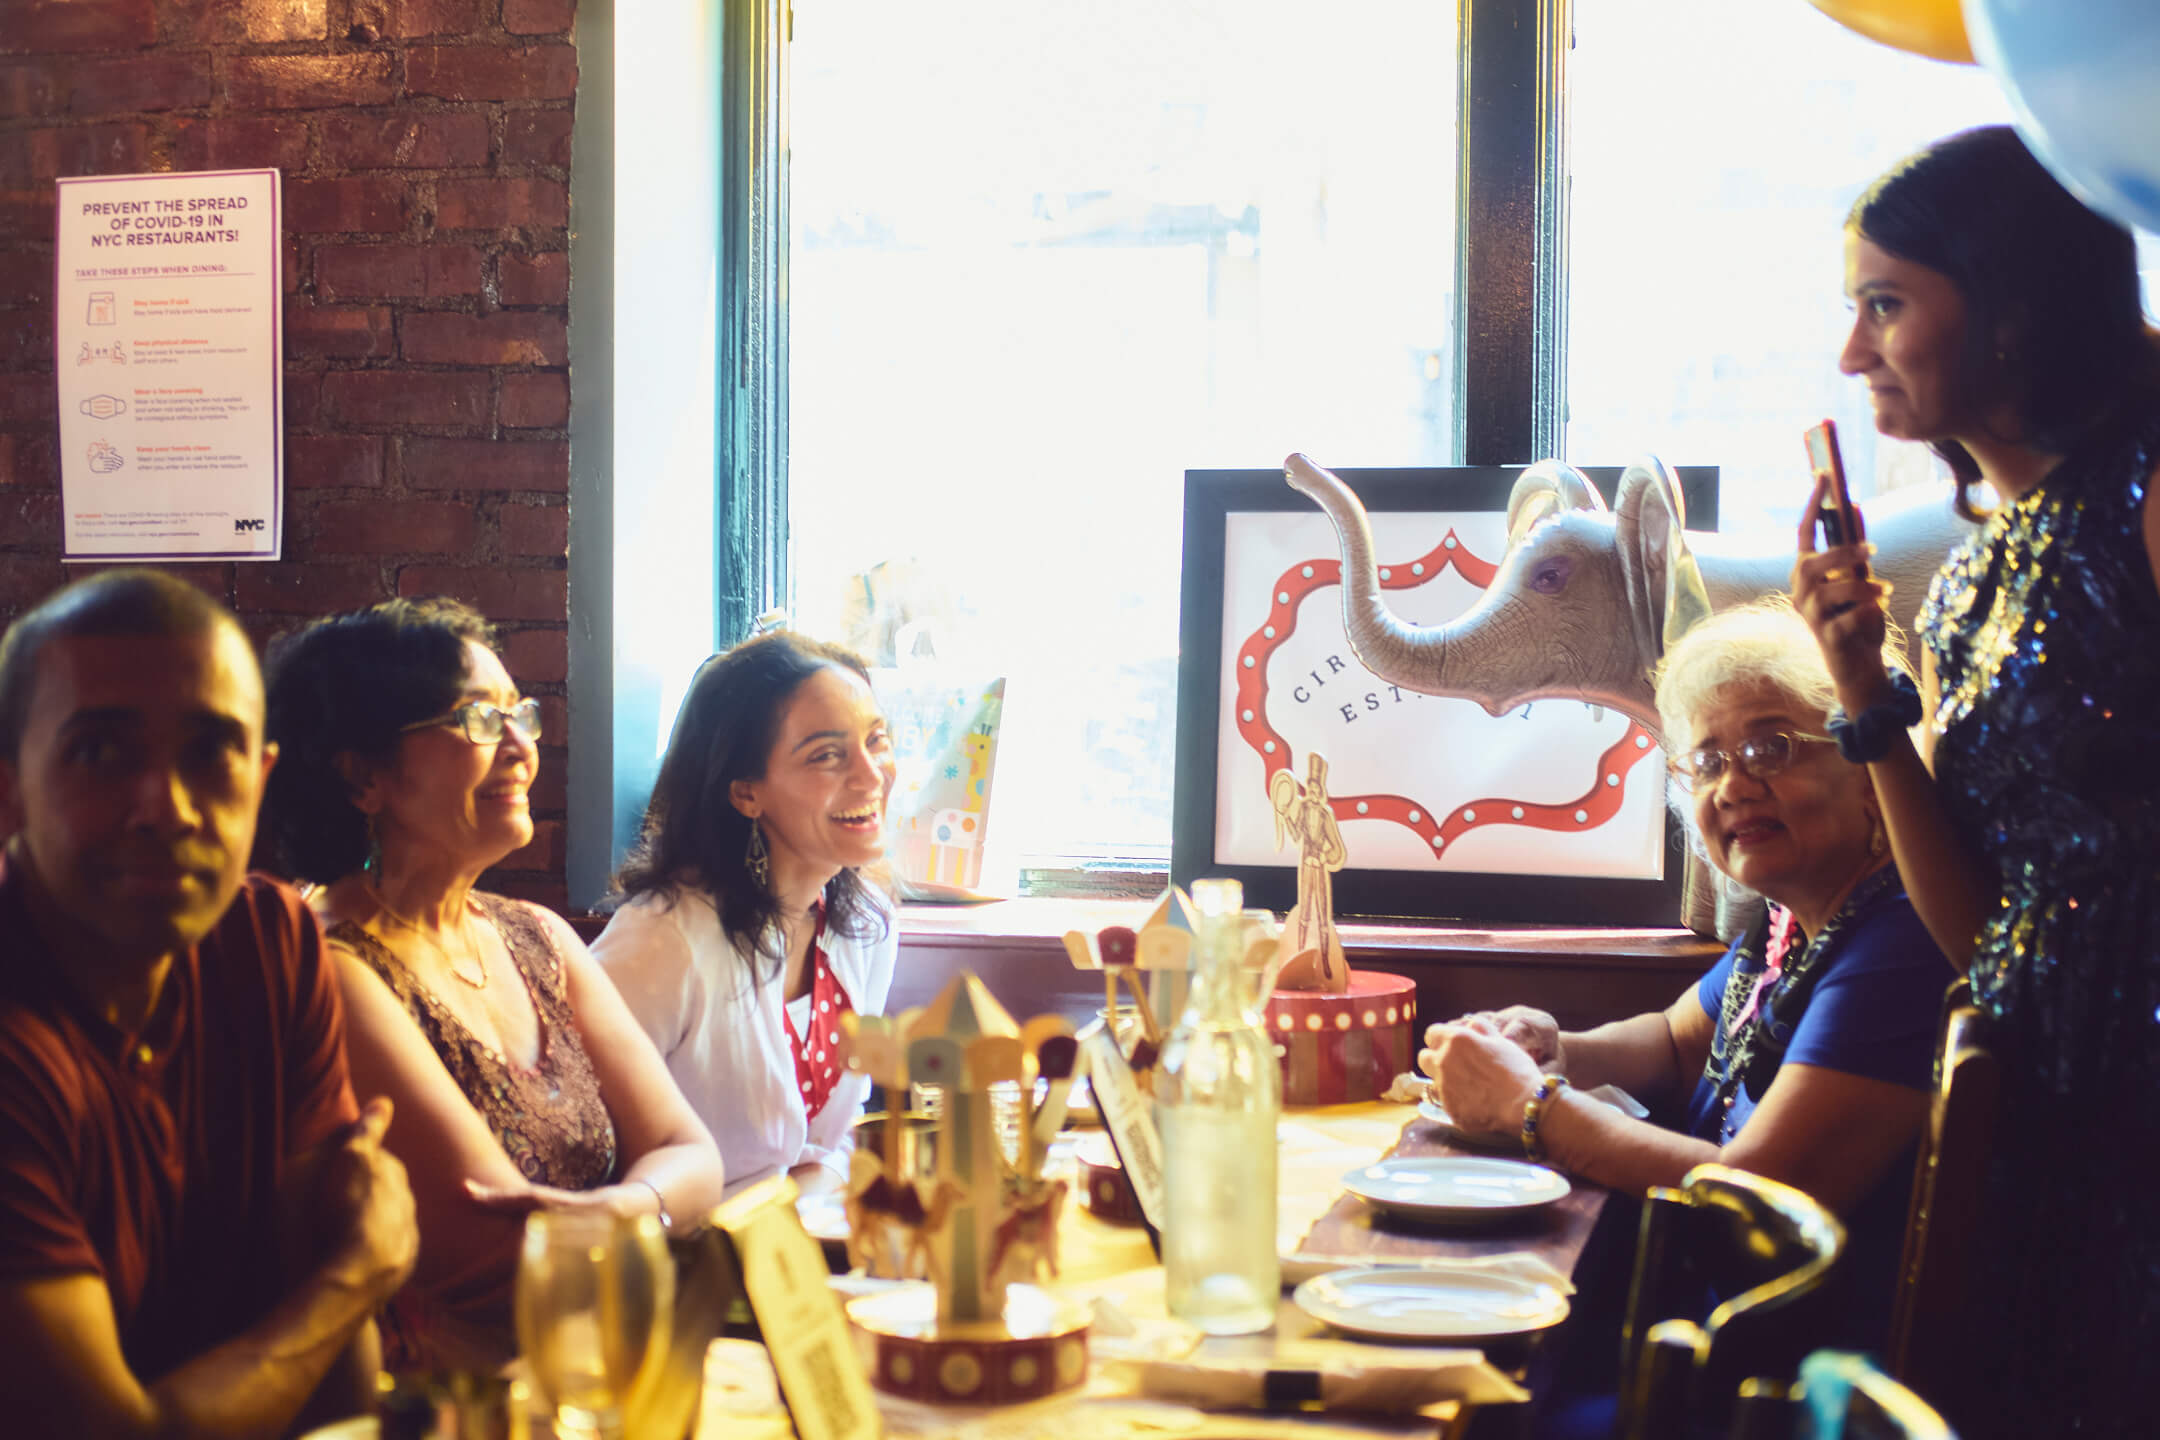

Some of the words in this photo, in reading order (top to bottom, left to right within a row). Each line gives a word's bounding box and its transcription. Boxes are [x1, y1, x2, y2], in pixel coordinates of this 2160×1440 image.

[82, 201, 150, 216] PREVENT
[155, 199, 184, 213] THE
[188, 197, 248, 211] SPREAD
[110, 217, 130, 231] OF
[134, 214, 204, 230] COVID-19
[208, 214, 224, 227] IN
[91, 233, 122, 247] NYC
[126, 230, 239, 246] RESTAURANTS!
[75, 269, 97, 277] TAKE
[100, 267, 128, 276] THESE
[131, 266, 159, 275] STEPS
[160, 265, 189, 274] WHEN
[234, 519, 265, 531] NYC
[1294, 655, 1346, 704] CIR
